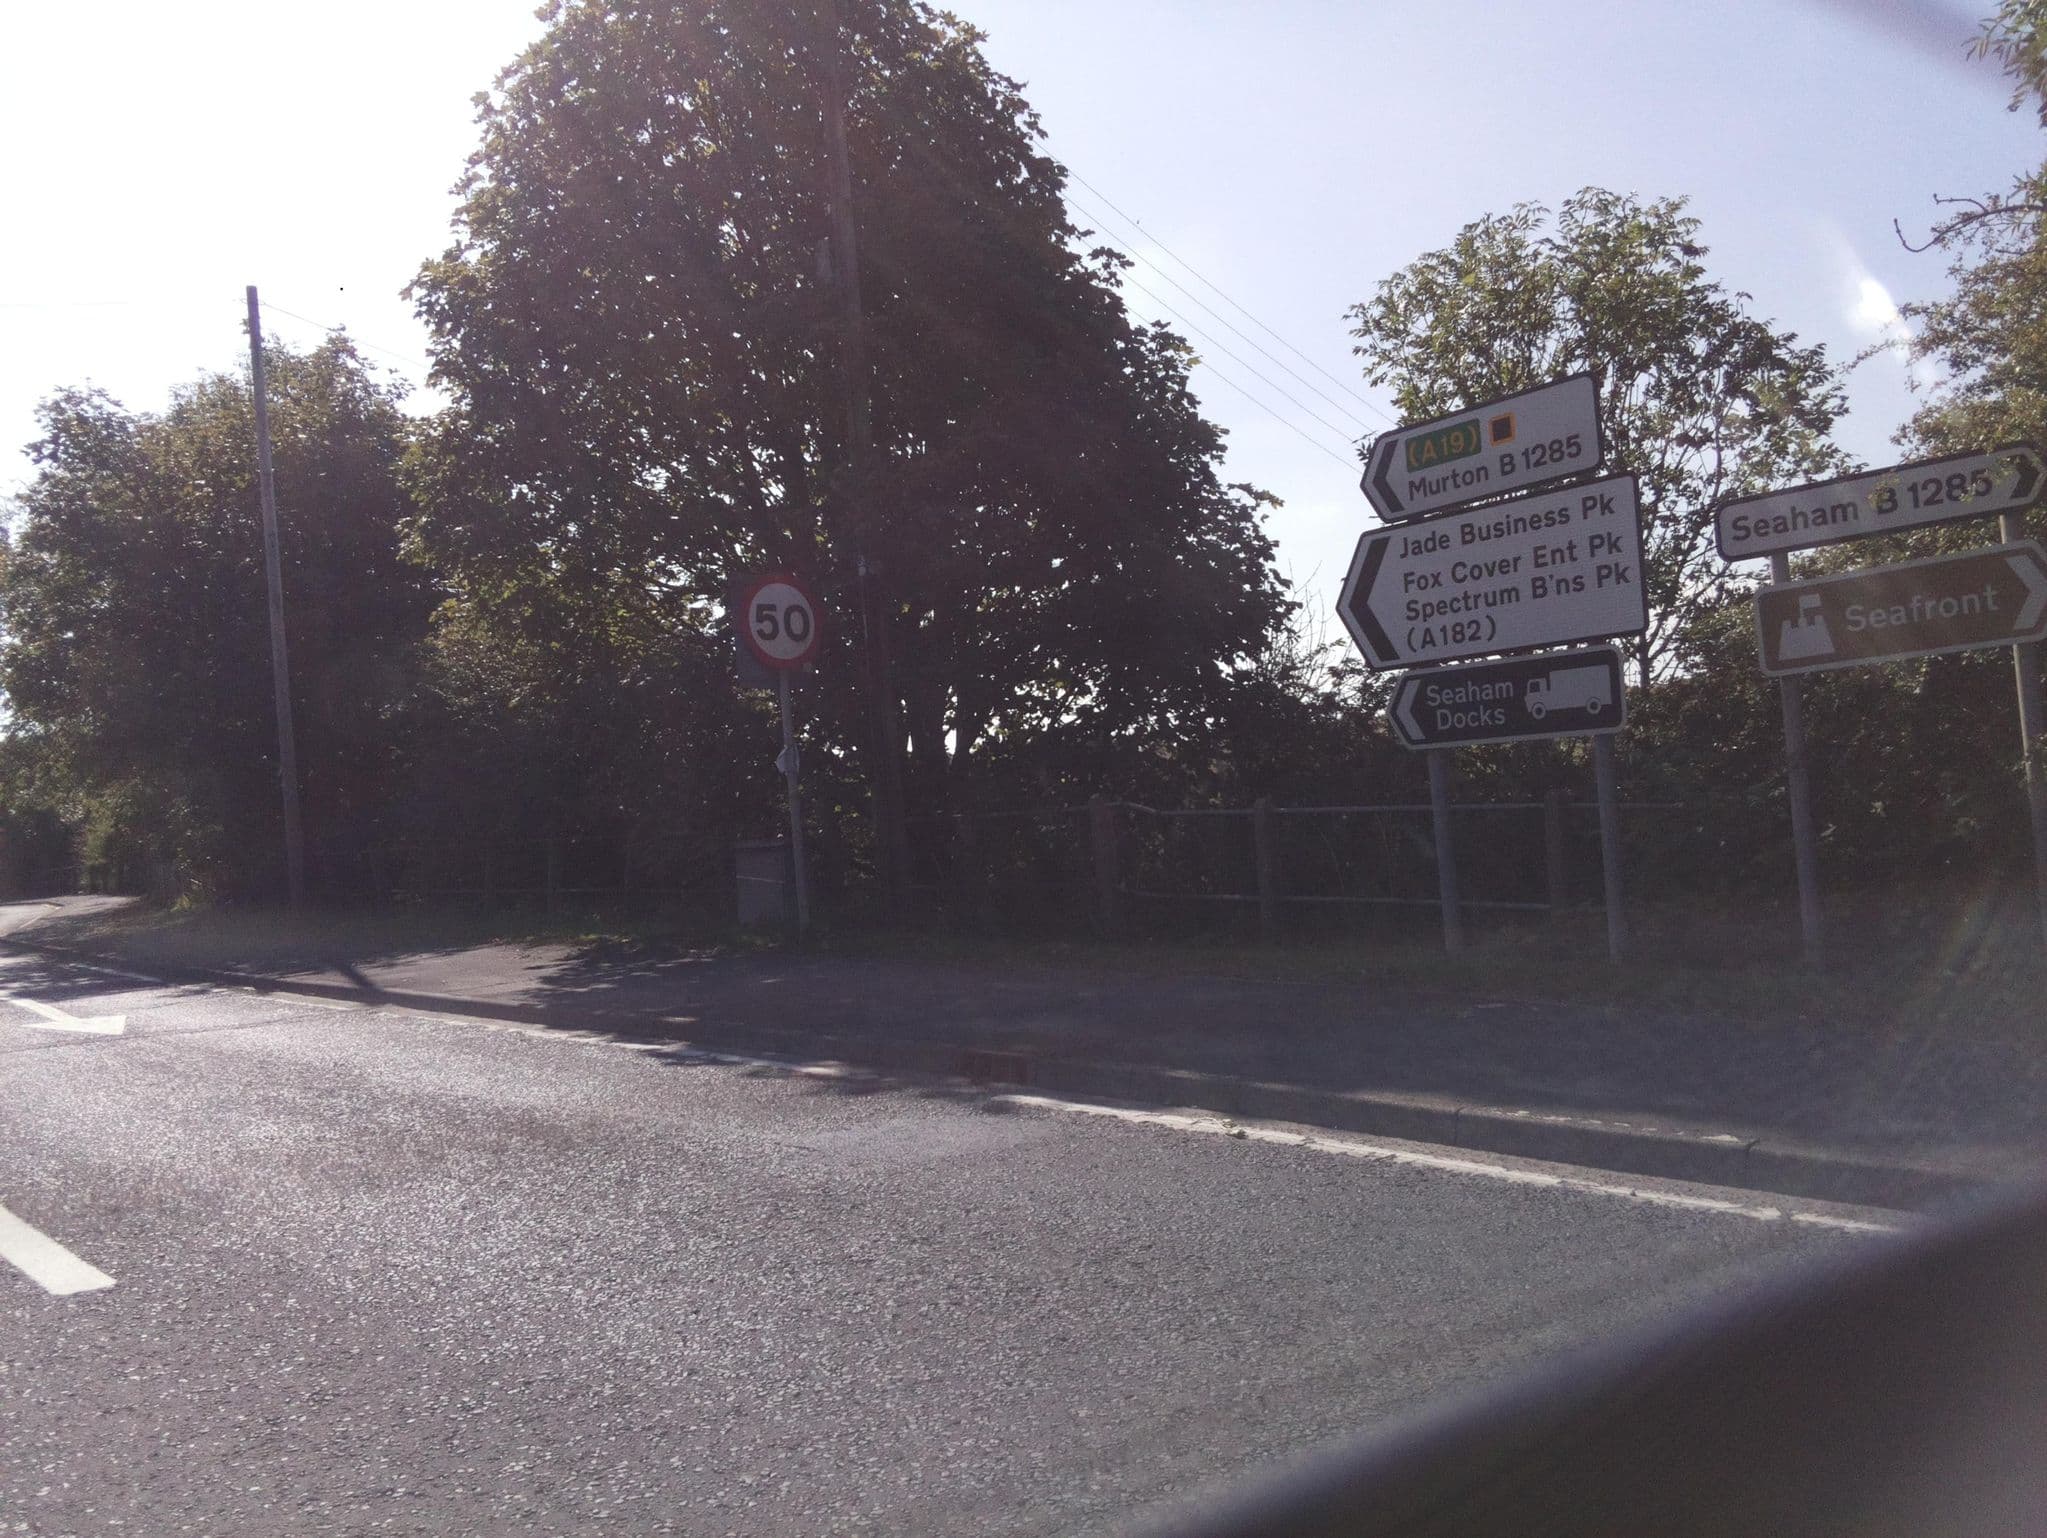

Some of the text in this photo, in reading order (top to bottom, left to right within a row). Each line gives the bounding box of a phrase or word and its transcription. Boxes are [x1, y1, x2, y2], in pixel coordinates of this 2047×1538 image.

[1408, 425, 1478, 465] (A19)
[1409, 464, 1489, 499] Murton
[1400, 493, 1616, 559] Jade Business Pk
[1731, 500, 1859, 541] Seaham
[1403, 531, 1624, 593] Fox Cover Ent Pk
[1406, 562, 1631, 622] Spectrum B'ns Pk
[1845, 584, 1999, 632] Seafront
[755, 604, 810, 642] 50
[1406, 615, 1497, 653] (A182)
[1426, 681, 1514, 706] Seaham
[1436, 705, 1505, 730] Docks
